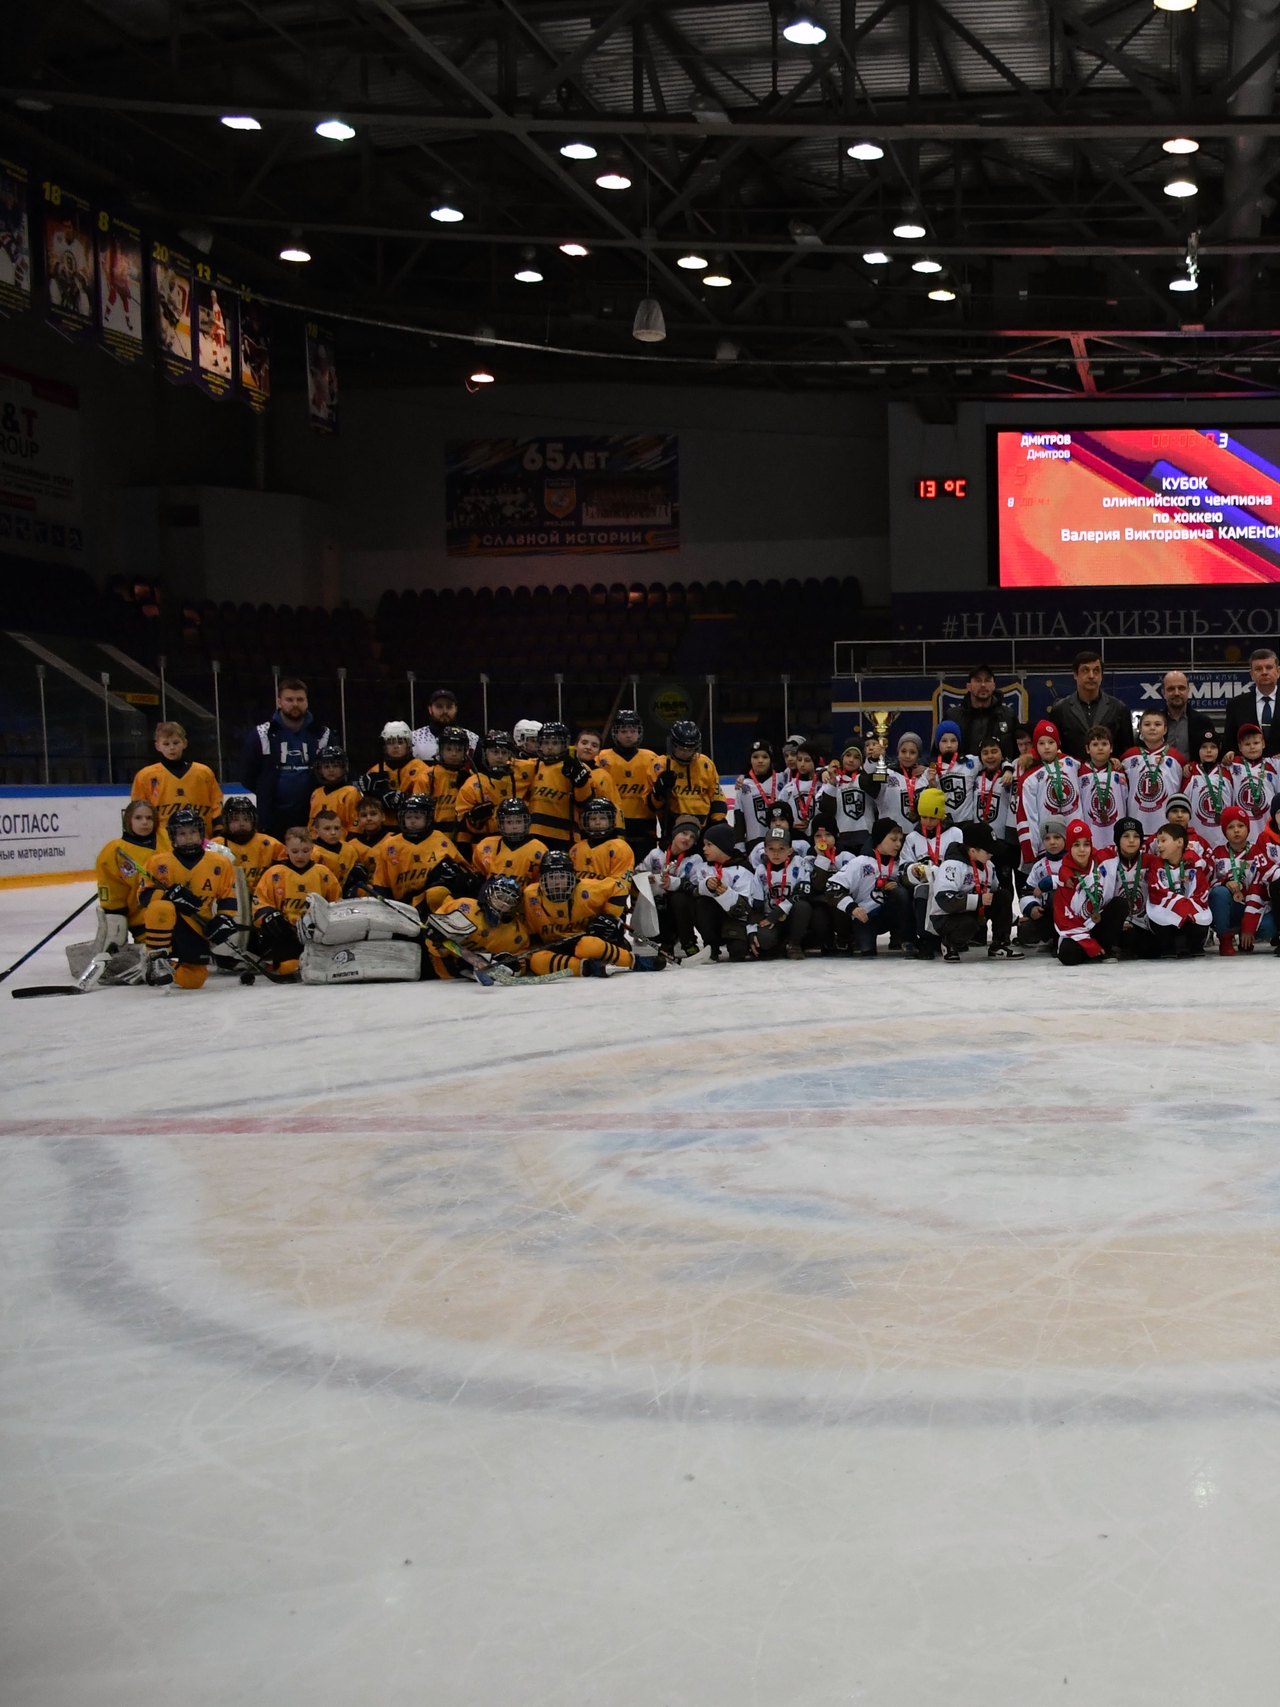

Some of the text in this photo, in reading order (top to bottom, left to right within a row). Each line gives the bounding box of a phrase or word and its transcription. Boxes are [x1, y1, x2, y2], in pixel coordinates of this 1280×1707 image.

[1020, 434, 1072, 447] ДМИТРОВ
[1218, 433, 1229, 448] 3
[1026, 449, 1071, 461] Дмитров
[920, 480, 937, 498] 13
[1162, 477, 1208, 490] КУБОК
[1102, 493, 1273, 508] олимпийского чемпиона
[1152, 511, 1223, 524] по хоккею
[482, 530, 642, 548] СЛАВНОЙ ИСТОРИИ
[1061, 529, 1121, 543] Валерия
[1124, 528, 1214, 543] Викторовича
[942, 611, 1072, 639] #НАША
[1215, 673, 1238, 681] КЛУБ
[1139, 681, 1256, 700] ХМИК
[0, 813, 60, 834] ОГЛАСС
[17, 847, 66, 861] материалы
